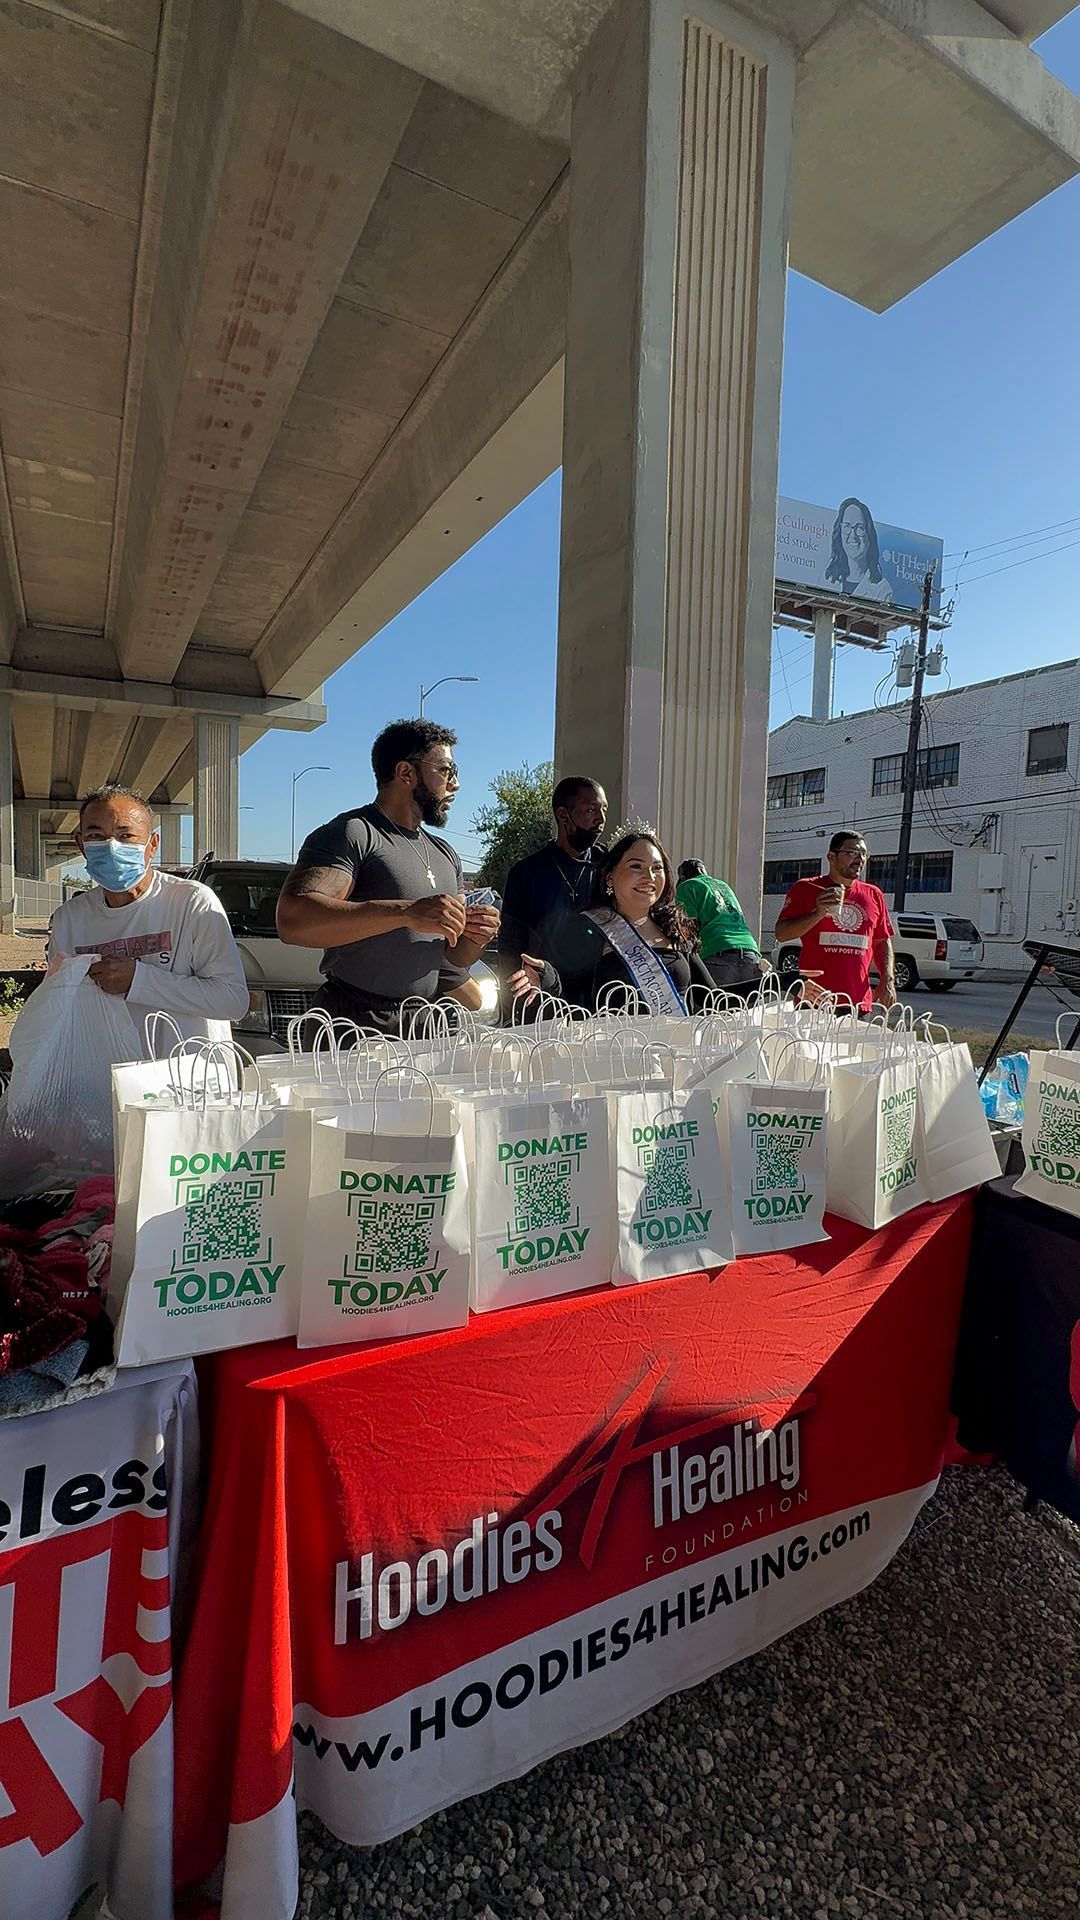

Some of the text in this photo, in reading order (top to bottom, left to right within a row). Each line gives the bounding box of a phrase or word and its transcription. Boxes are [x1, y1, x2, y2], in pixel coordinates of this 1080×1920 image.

[776, 514, 828, 540] cCullough
[791, 538, 820, 552] stroke
[782, 553, 816, 568] women
[891, 551, 936, 574] UTHeal
[896, 565, 926, 585] Houst
[625, 945, 673, 1016] SPECTACULAR
[881, 1086, 917, 1113] DONATE
[1039, 1080, 1080, 1105] DONA
[632, 1120, 700, 1145] DONATE
[746, 1112, 823, 1131] DONATE
[498, 1132, 588, 1162] DONATE
[169, 1149, 286, 1177] DONATE
[879, 1158, 918, 1194] TODAY
[1029, 1154, 1080, 1184] TOD
[339, 1170, 456, 1194] DONATE
[744, 1194, 813, 1219] TODAY
[633, 1209, 713, 1245] TODAY
[496, 1228, 590, 1270] TODAY
[642, 1233, 708, 1252] HOODIES4HEALING.ORG
[508, 1253, 582, 1276] HOODIES4HEALING.ORG
[153, 1264, 287, 1308] TODAY
[327, 1268, 448, 1308] TODAY
[166, 1296, 273, 1318] HOODIES4HEALING.ORG
[341, 1294, 435, 1315] HOODIES4HEALING.ORG
[334, 1508, 563, 1646] Hoodies
[651, 1418, 802, 1529] Healing
[644, 1488, 809, 1572] FOUNDATION
[292, 1506, 871, 1773] ww.HOODIES4HEALING.com
